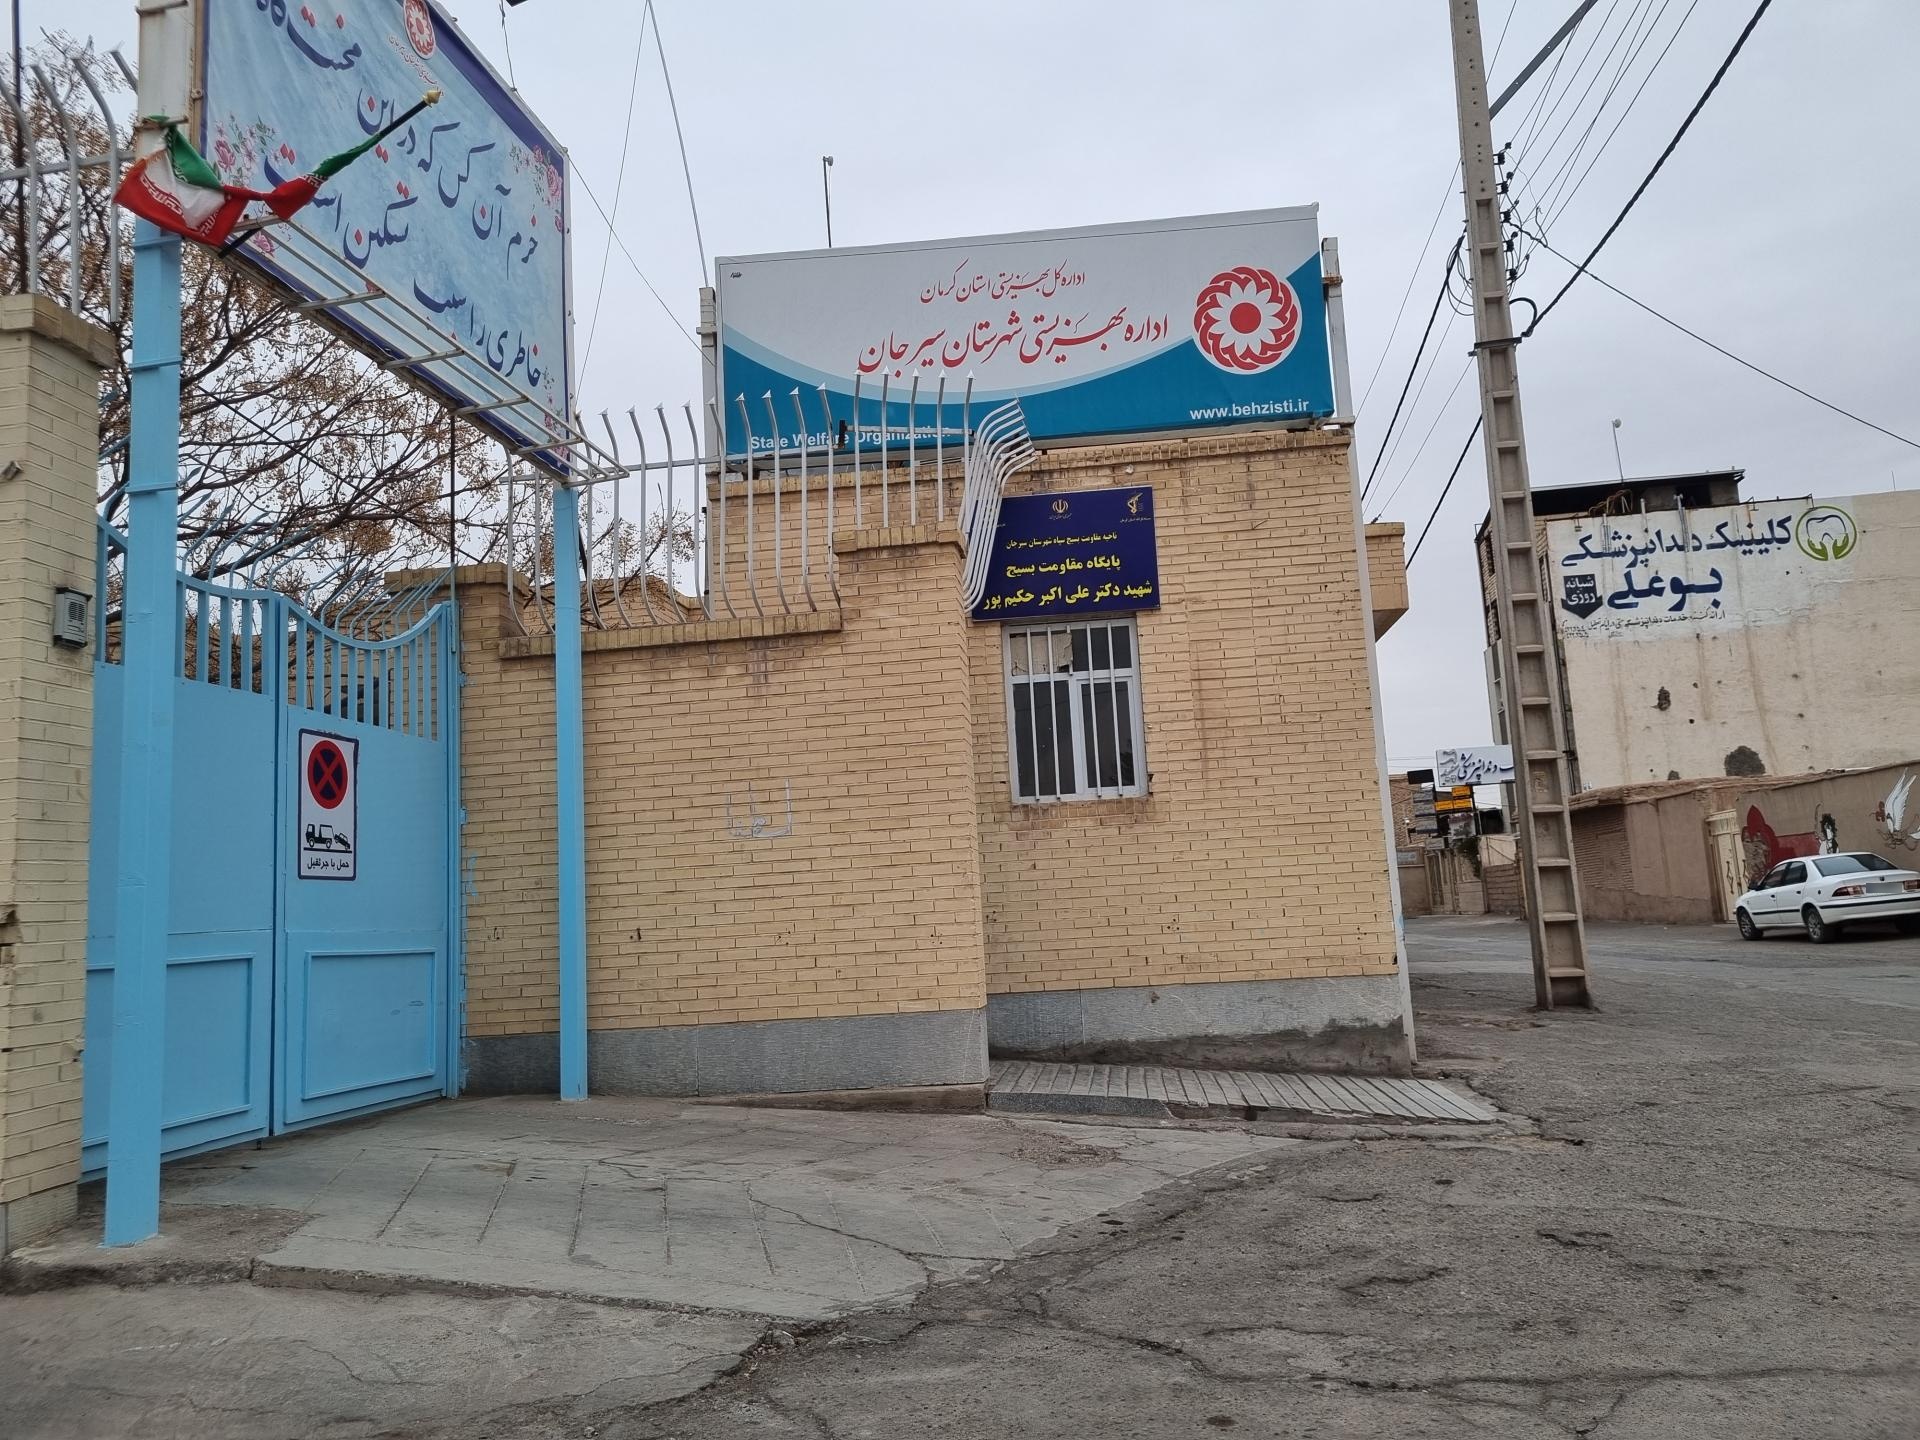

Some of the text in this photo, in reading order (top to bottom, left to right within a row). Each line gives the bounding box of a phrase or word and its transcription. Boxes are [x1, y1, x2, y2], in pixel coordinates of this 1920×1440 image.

[396, 124, 416, 155] در
[417, 121, 462, 173] که
[437, 142, 497, 209] کس
[343, 180, 419, 271] تسکین
[471, 184, 512, 241] آن
[506, 204, 538, 281] خرم
[920, 256, 1086, 304] اداره کل بهزیستی استان کرمان
[470, 303, 486, 347] را
[941, 309, 1024, 368] شهرستان
[1018, 306, 1128, 365] بهزیستی
[1123, 312, 1169, 343] اداره
[486, 329, 541, 388] خاطری
[1189, 398, 1310, 420] www.behzisti.ir
[750, 435, 789, 450] Stae
[1028, 536, 1053, 549] شهرستان
[1053, 536, 1066, 547] سپاه
[1066, 535, 1080, 546] بسیج
[1080, 532, 1102, 545] مقاومت
[1102, 530, 1118, 541] ناحیه
[1705, 514, 1793, 556] کلینیک
[1006, 554, 1121, 578] پایگاه مقاومت بسیج
[983, 580, 1153, 610] شهید دکتر علی اکبر حکیم پور
[1566, 575, 1595, 588] شبانه
[1566, 588, 1596, 606] روزی
[1458, 752, 1498, 780] دندانپزشکی
[307, 857, 350, 870] حمل با جرثقیل
